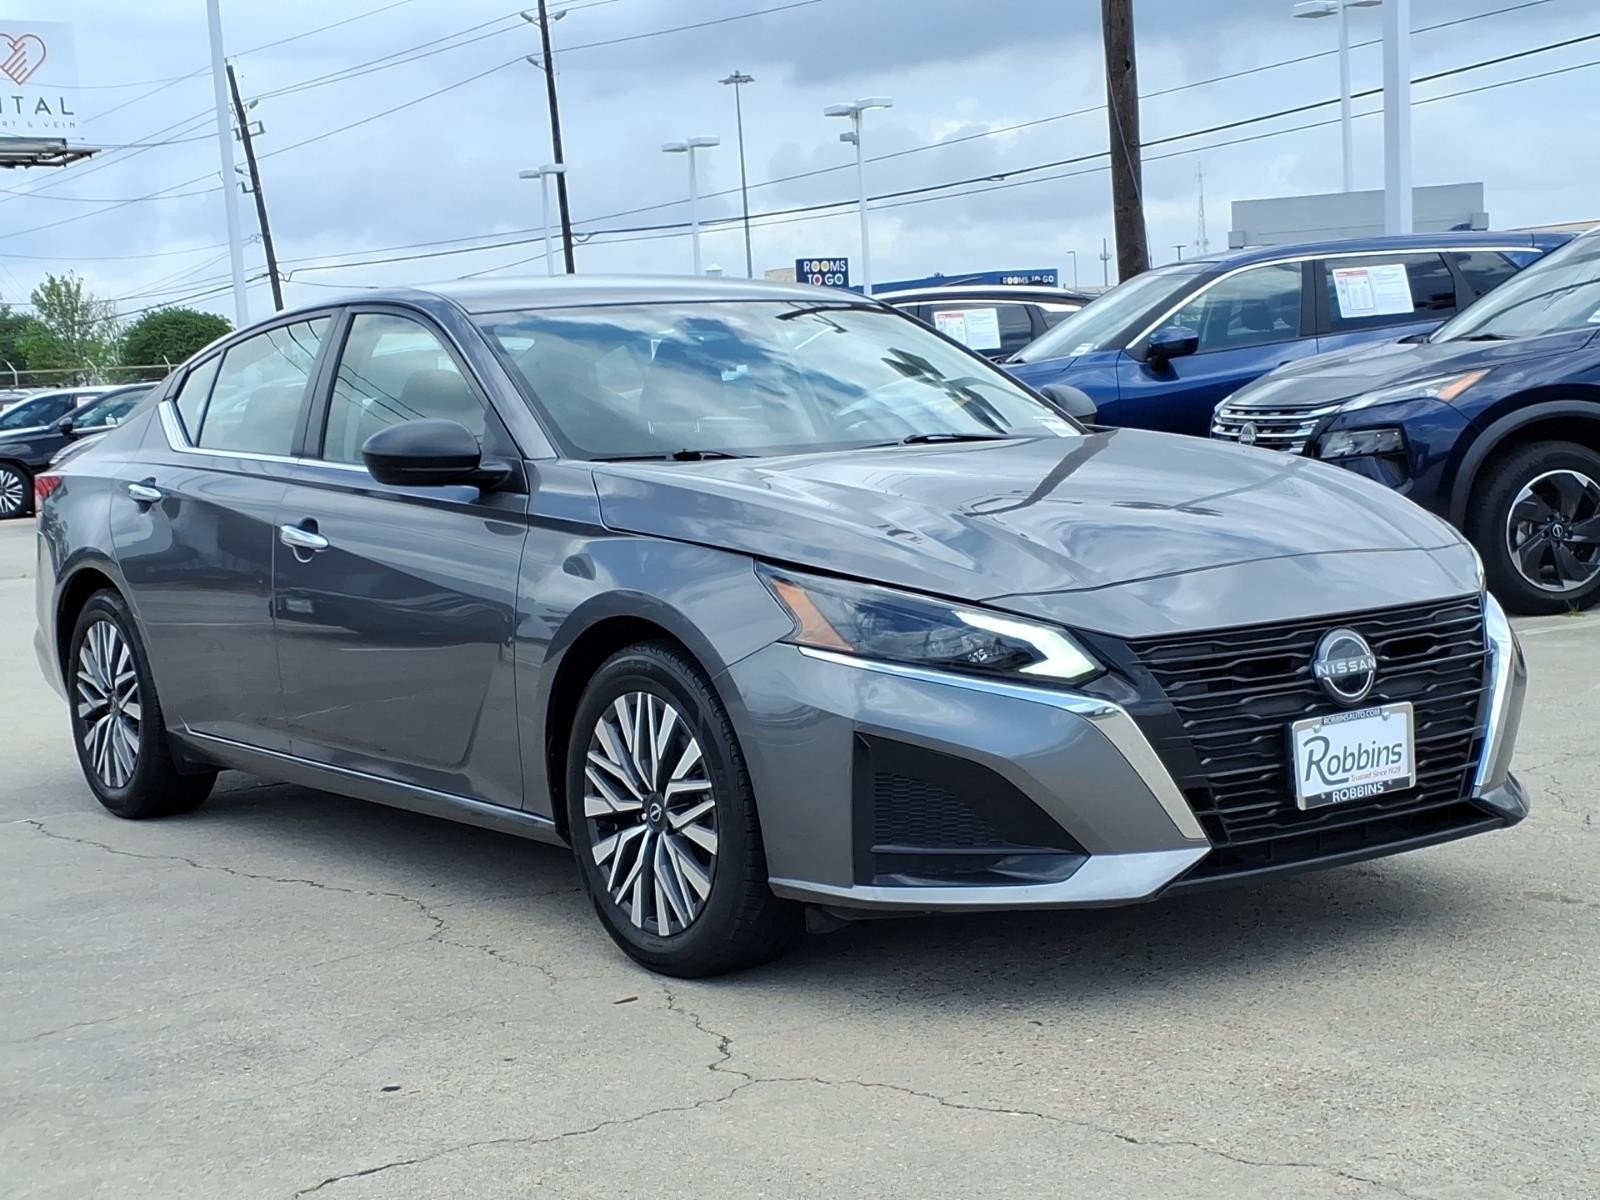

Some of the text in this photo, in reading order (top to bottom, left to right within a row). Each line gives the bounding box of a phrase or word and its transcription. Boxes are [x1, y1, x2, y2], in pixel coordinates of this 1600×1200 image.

[803, 260, 846, 272] ROOMS
[807, 273, 844, 286] TO GO
[1002, 276, 1029, 285] ROOMS
[1042, 274, 1054, 283] GO
[1316, 658, 1377, 676] NISSAN
[1303, 735, 1403, 786] Robbins
[1332, 782, 1384, 803] ROBBINS
